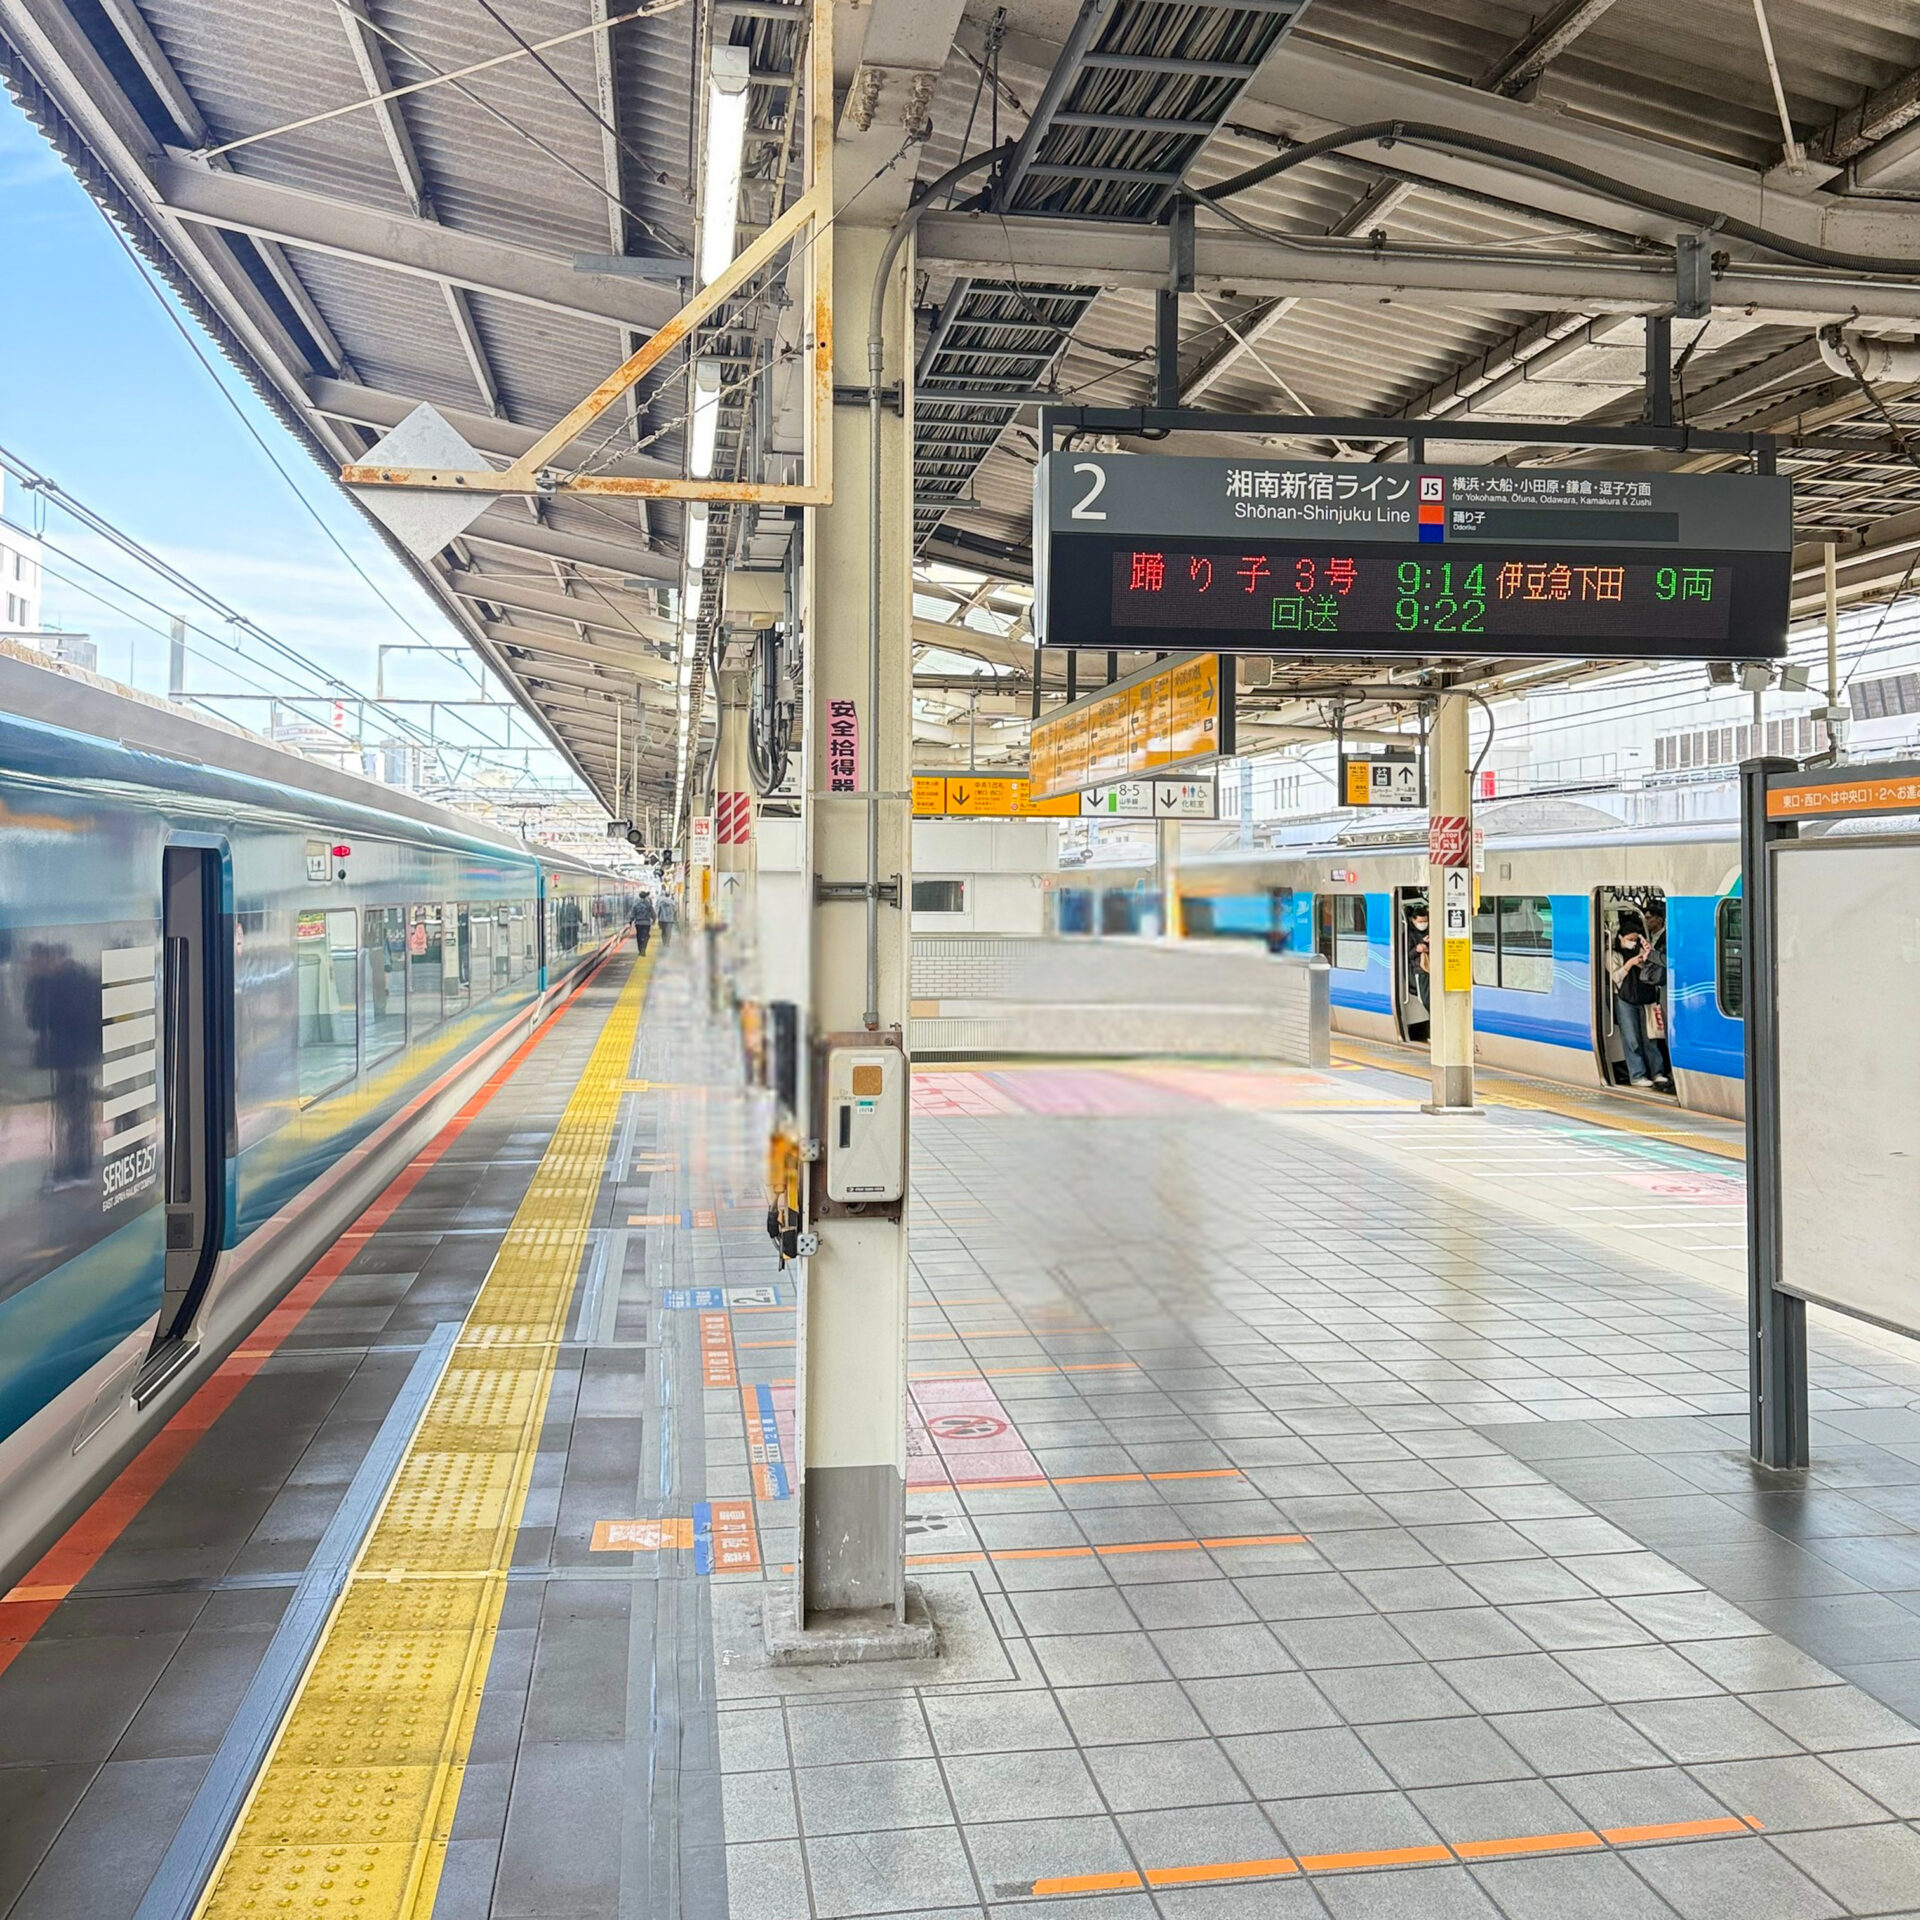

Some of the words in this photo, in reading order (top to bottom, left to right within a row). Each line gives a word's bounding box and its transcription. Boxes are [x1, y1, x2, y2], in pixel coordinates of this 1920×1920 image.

[1071, 462, 1107, 520] 2
[1226, 469, 1411, 501] 湘南新宿ライン
[1423, 481, 1439, 496] JS
[1452, 492, 1464, 502] for
[1465, 493, 1509, 504] Yokohama,
[1540, 495, 1578, 506] Odawara,
[1580, 496, 1620, 506] Kamakura
[1622, 497, 1629, 506] &
[1630, 497, 1652, 507] Zushi
[1234, 502, 1372, 525] Shōnan-Shinjuku
[1377, 507, 1411, 523] Line
[1452, 510, 1487, 525] 踊り子
[1397, 561, 1486, 597] 9:14
[1496, 561, 1625, 601] 伊豆急下田
[1655, 566, 1715, 602] 9両
[1271, 593, 1339, 632] 回送
[1395, 597, 1486, 633] 9:22
[102, 1153, 136, 1196] SERIES
[135, 1142, 157, 1178] E257
